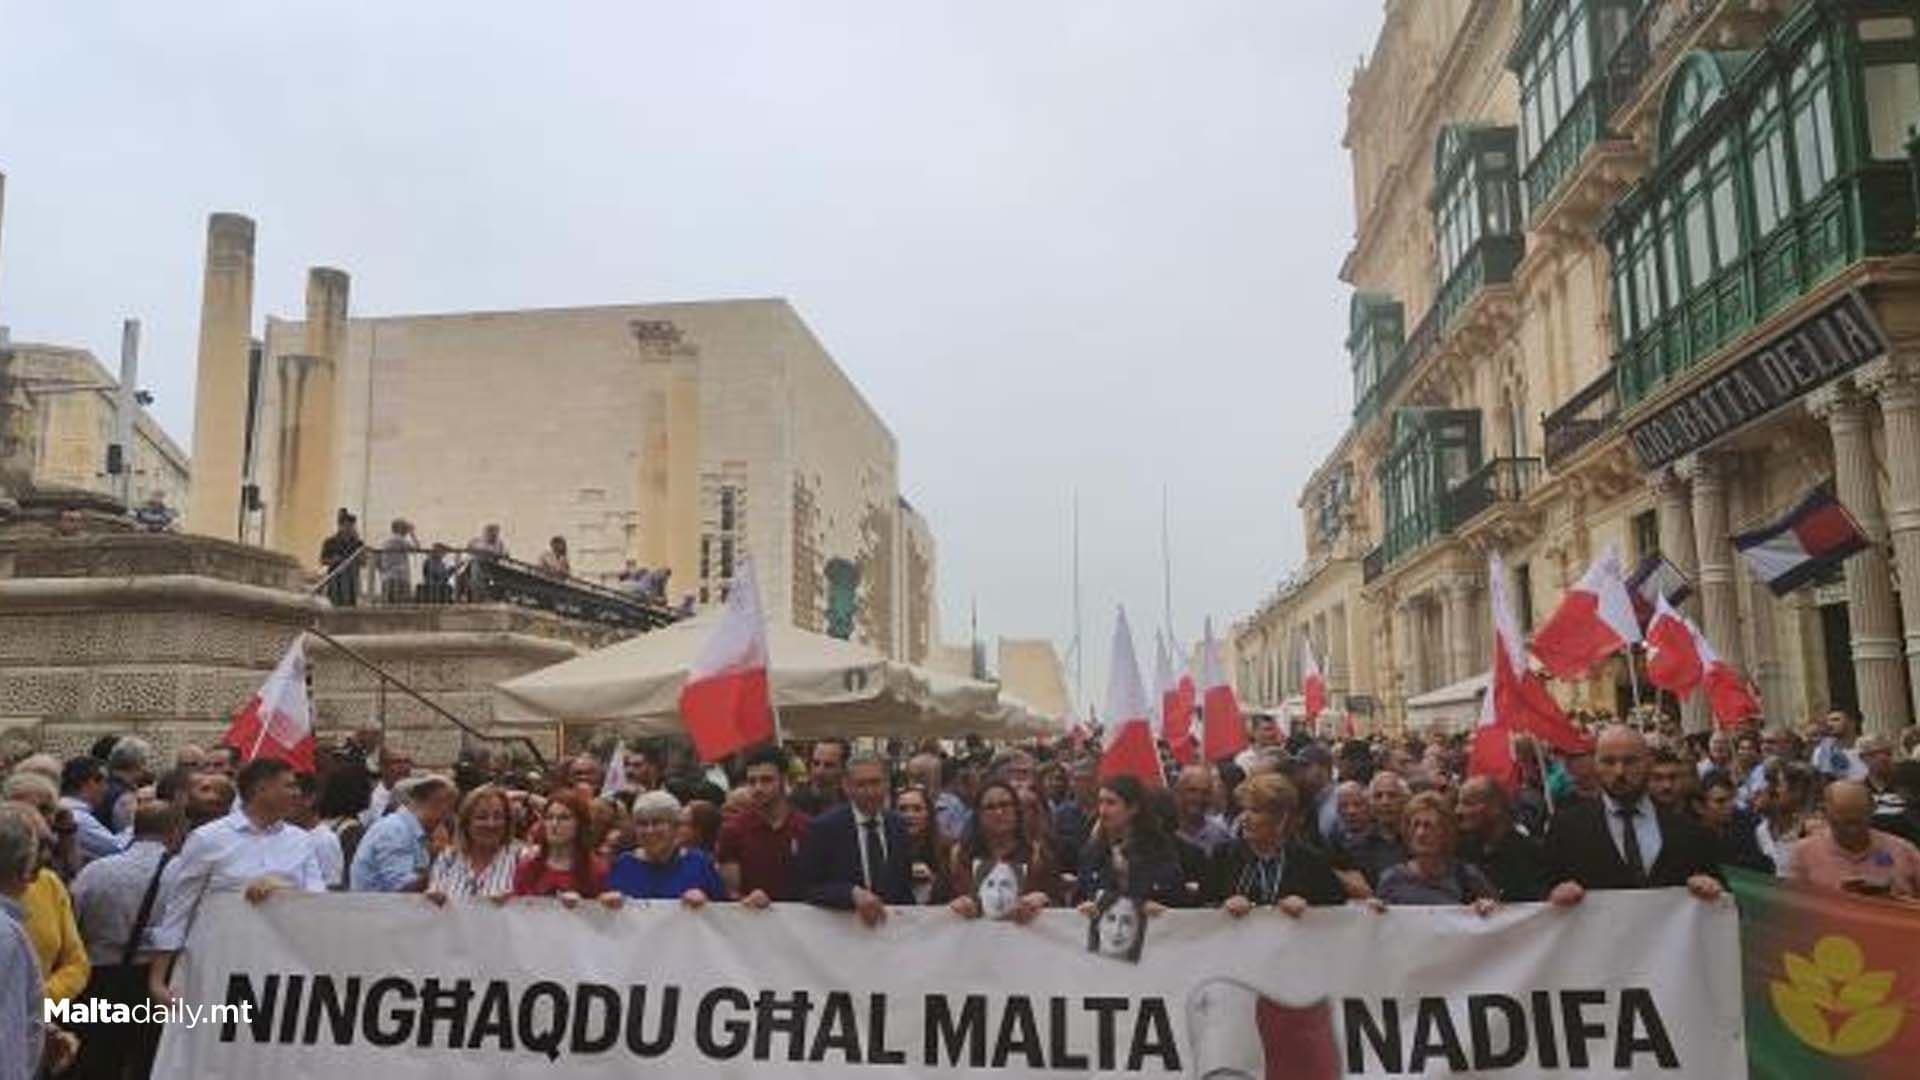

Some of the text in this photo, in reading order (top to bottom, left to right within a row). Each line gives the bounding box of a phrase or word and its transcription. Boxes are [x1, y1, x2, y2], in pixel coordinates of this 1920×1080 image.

[1759, 308, 1876, 392] DELIA
[219, 973, 1681, 1075] NINGĦAQDU GĦAL MALTA NADIFA
